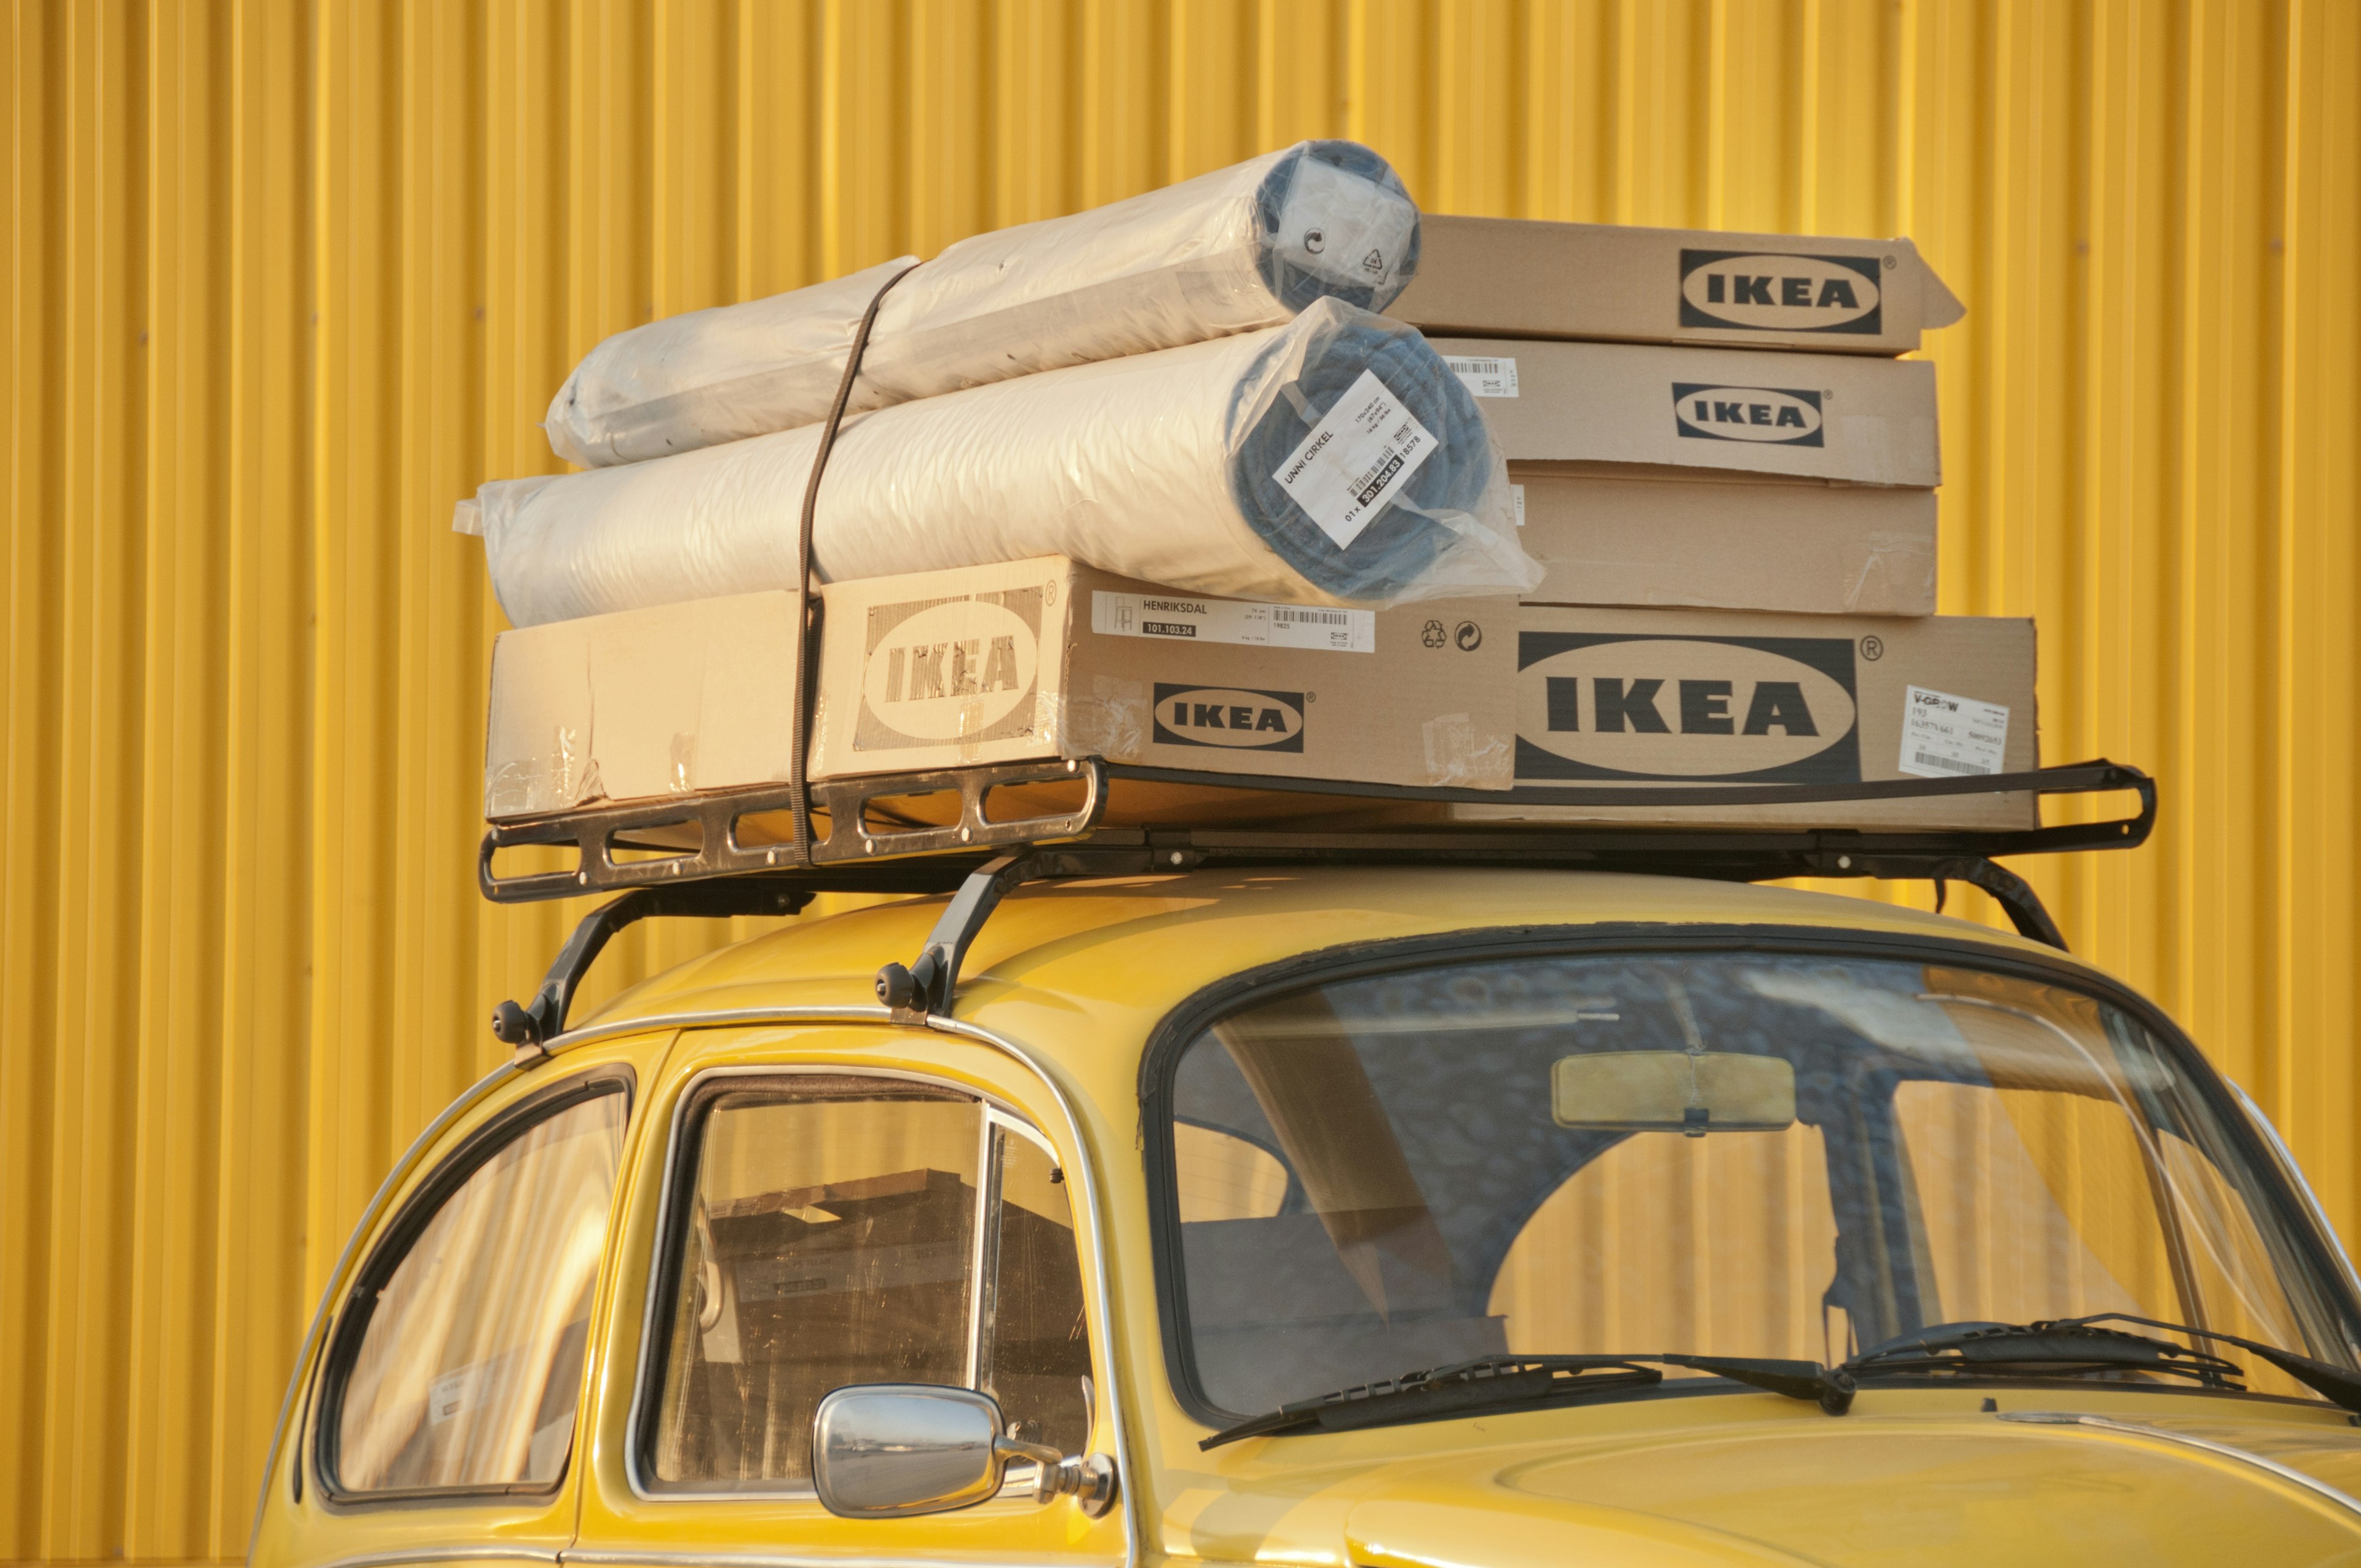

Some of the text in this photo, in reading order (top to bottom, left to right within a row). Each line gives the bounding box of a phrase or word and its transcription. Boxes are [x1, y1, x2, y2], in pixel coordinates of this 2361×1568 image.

[1707, 274, 1859, 309] IKEA
[1355, 403, 1374, 423] 170x240
[1695, 401, 1807, 428] IKEA
[1284, 431, 1334, 484] UNNI CIRKEL
[1345, 511, 1355, 522] 01
[1362, 459, 1401, 503] 301.204.83
[1399, 436, 1420, 458] 18578
[1144, 600, 1207, 614] HENRIKSDAL
[1147, 623, 1192, 635] 101.103.24
[887, 635, 1019, 703] IKEA
[1174, 702, 1288, 733] IKEA
[1546, 677, 1820, 737] IKEA
[1912, 707, 1927, 717] 193
